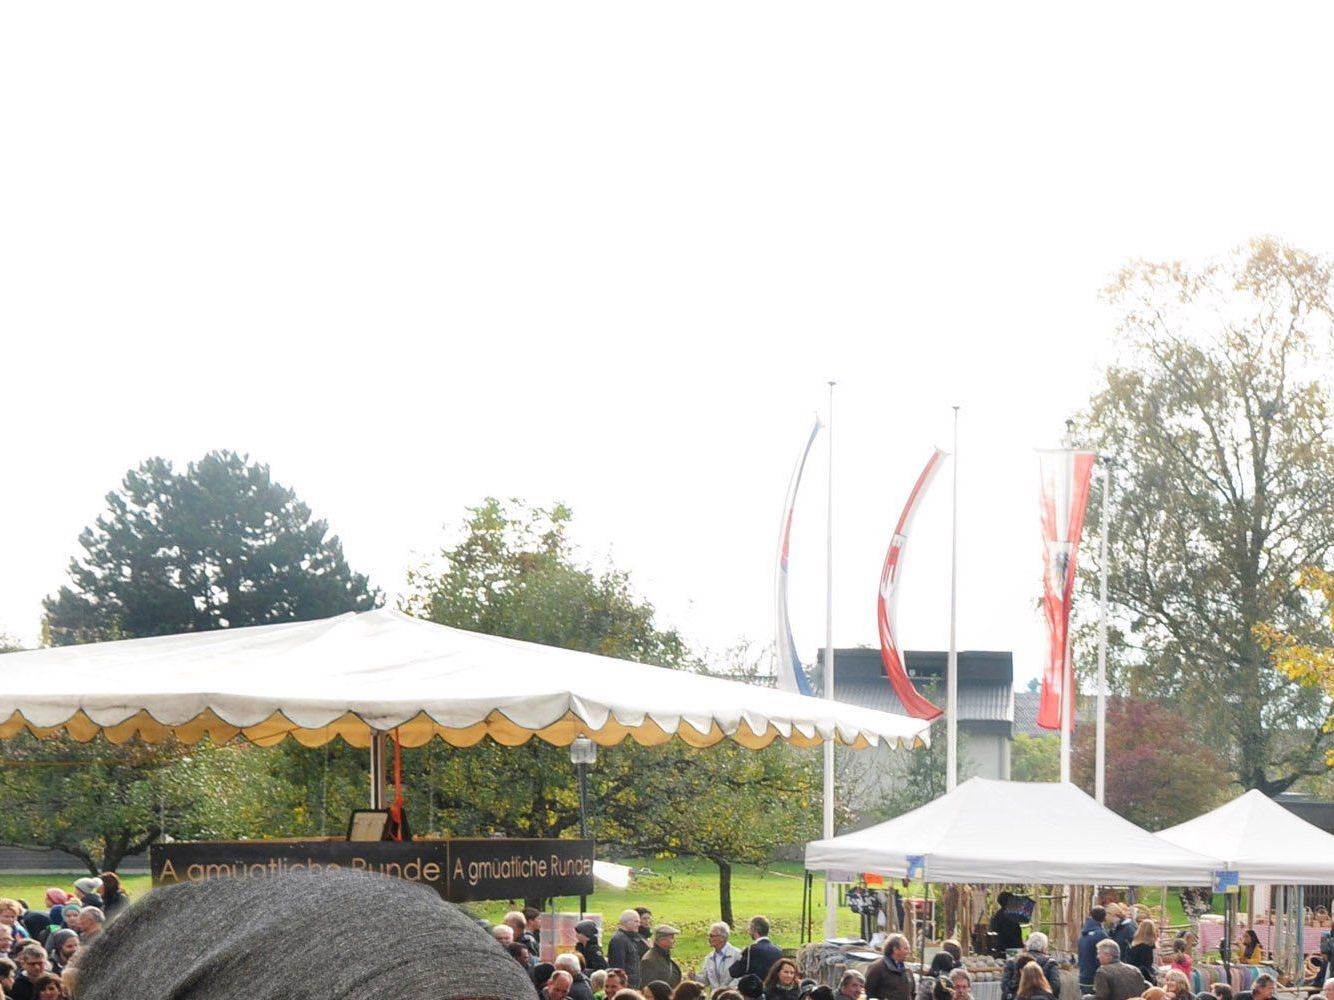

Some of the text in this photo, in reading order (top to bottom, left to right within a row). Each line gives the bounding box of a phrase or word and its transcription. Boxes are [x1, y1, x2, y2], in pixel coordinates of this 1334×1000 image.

[159, 859, 179, 883] A
[351, 857, 441, 882] Runde
[453, 855, 591, 885] A gmüatliche Runde
